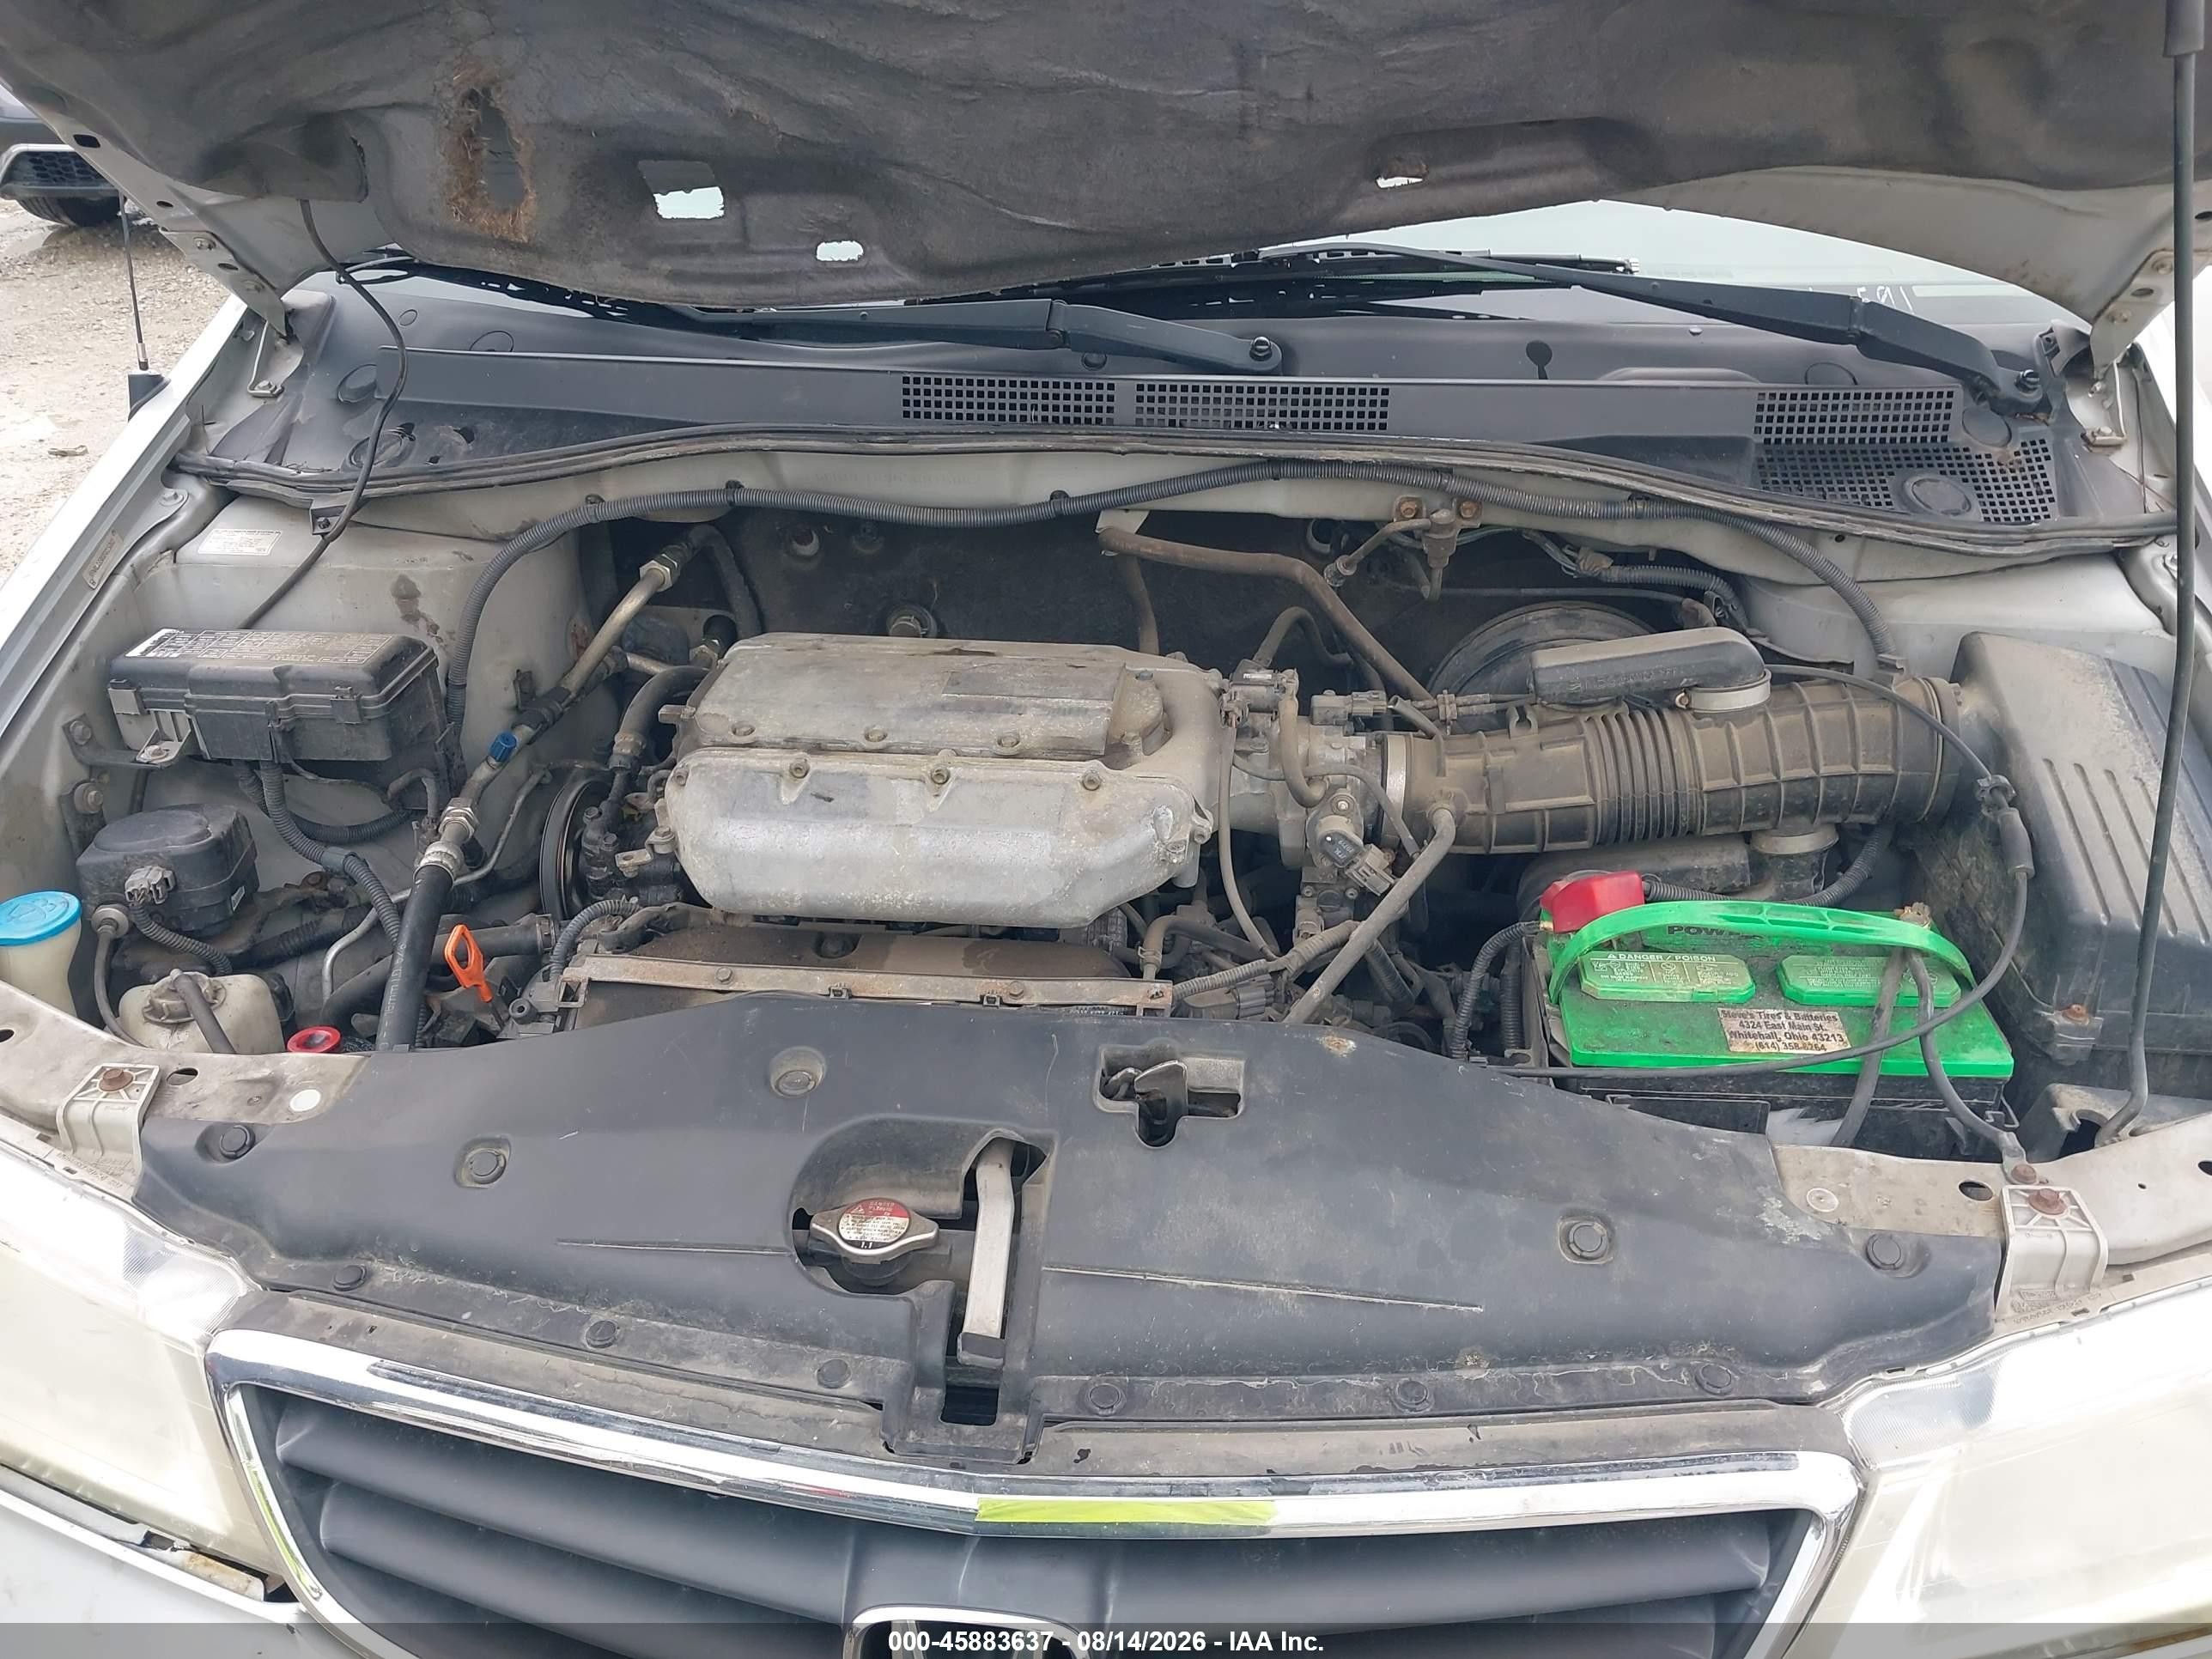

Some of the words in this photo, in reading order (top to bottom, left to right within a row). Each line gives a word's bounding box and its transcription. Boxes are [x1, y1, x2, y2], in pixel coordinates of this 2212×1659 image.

[1721, 1010, 1755, 1020] Steve's
[1759, 1012, 1783, 1020] Tires
[1794, 1012, 1838, 1022] Batteries
[1739, 1020, 1761, 1030] 4324
[1765, 1021, 1786, 1030] East
[1789, 1022, 1811, 1030] Main
[1814, 1022, 1827, 1030] St.
[1784, 1031, 1809, 1041] Ohio
[1813, 1033, 1844, 1042] 43213
[860, 1241, 873, 1249] 1.1
